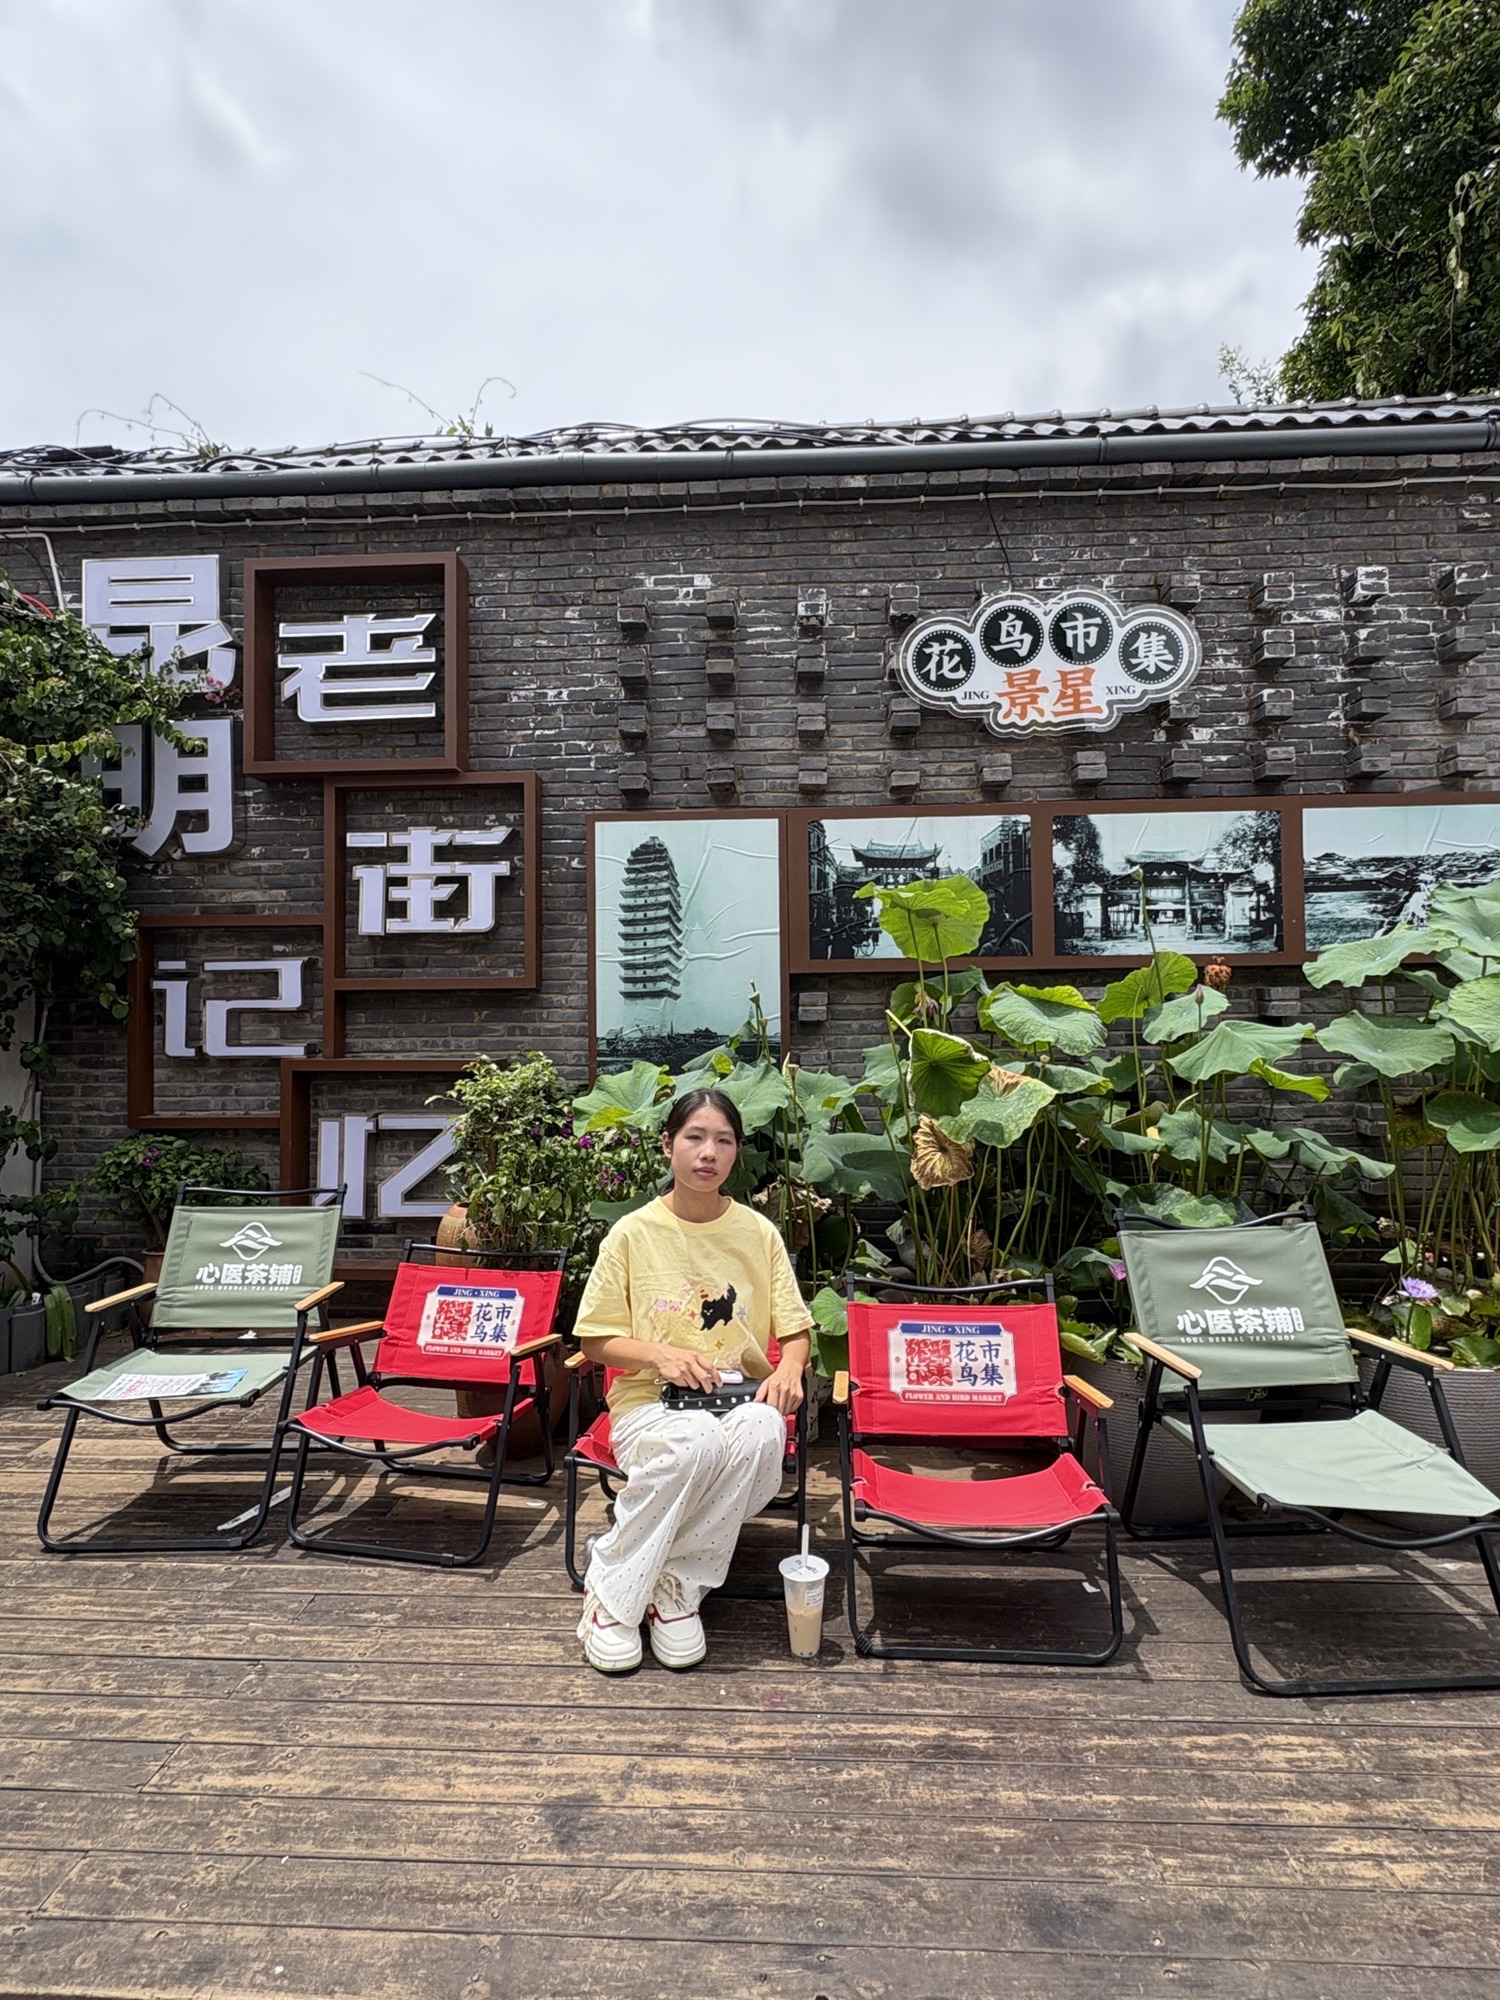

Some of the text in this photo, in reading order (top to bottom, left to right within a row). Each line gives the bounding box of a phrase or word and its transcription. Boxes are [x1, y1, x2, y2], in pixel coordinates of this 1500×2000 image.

[920, 612, 1174, 682] 花鸟市集
[961, 685, 1137, 701] JING XING
[995, 667, 1103, 721] 景星
[195, 1262, 292, 1286] 心医茶铺
[453, 1289, 500, 1298] JING XING
[921, 1325, 980, 1334] JING XING
[1176, 1306, 1295, 1335] 心医茶铺
[905, 1392, 1003, 1403] FLOWER AND BIRD MARKET
